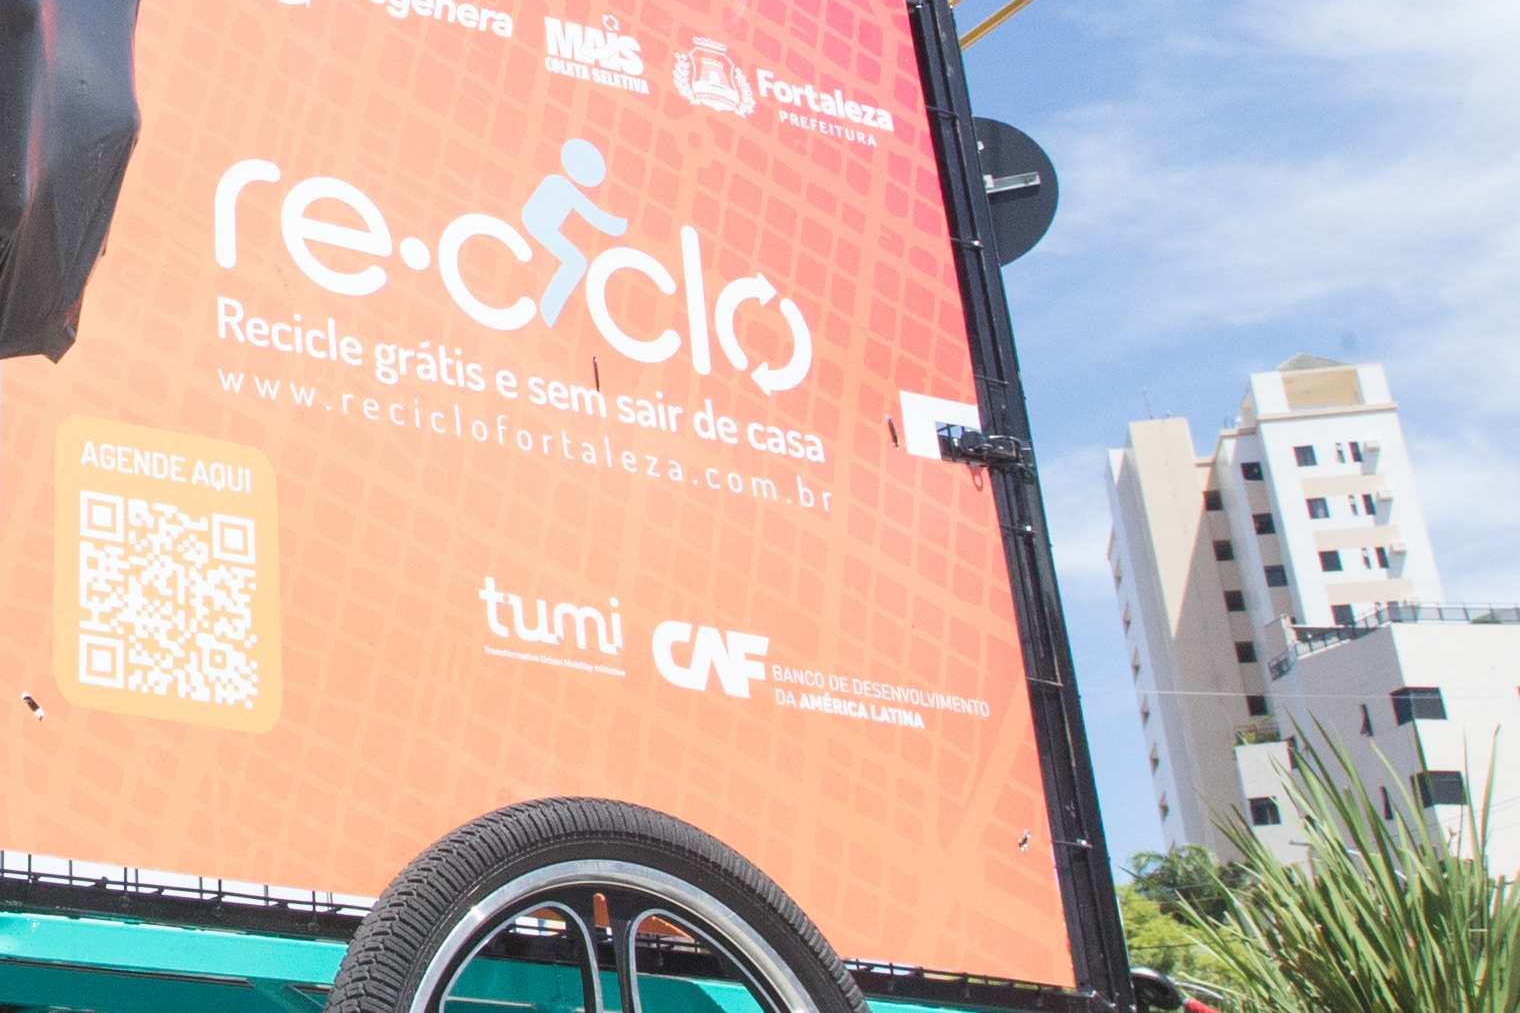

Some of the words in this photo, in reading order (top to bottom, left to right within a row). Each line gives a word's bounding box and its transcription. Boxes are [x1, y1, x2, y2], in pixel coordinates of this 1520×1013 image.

[544, 14, 644, 76] MAIS
[756, 68, 894, 132] Fortaleza
[779, 109, 877, 147] PREFEITURA
[217, 296, 363, 367] Recicle
[375, 339, 486, 392] grátis
[495, 368, 518, 399] e
[528, 376, 608, 418] sem
[616, 391, 684, 433] sair
[693, 398, 739, 445] de
[746, 422, 826, 463] casa
[80, 440, 187, 483] AGENDE
[191, 459, 252, 493] AQUI
[217, 368, 833, 511] www.reciclofortaleza.com.br
[478, 576, 624, 655] tumi
[652, 620, 769, 699] CAF
[772, 664, 825, 687] BANCO
[828, 674, 850, 693] DE
[852, 678, 991, 718] DESENVOLVIMENTO
[775, 688, 797, 707] DA
[799, 691, 868, 720] AMÉRICA
[870, 704, 926, 730] LATINA
